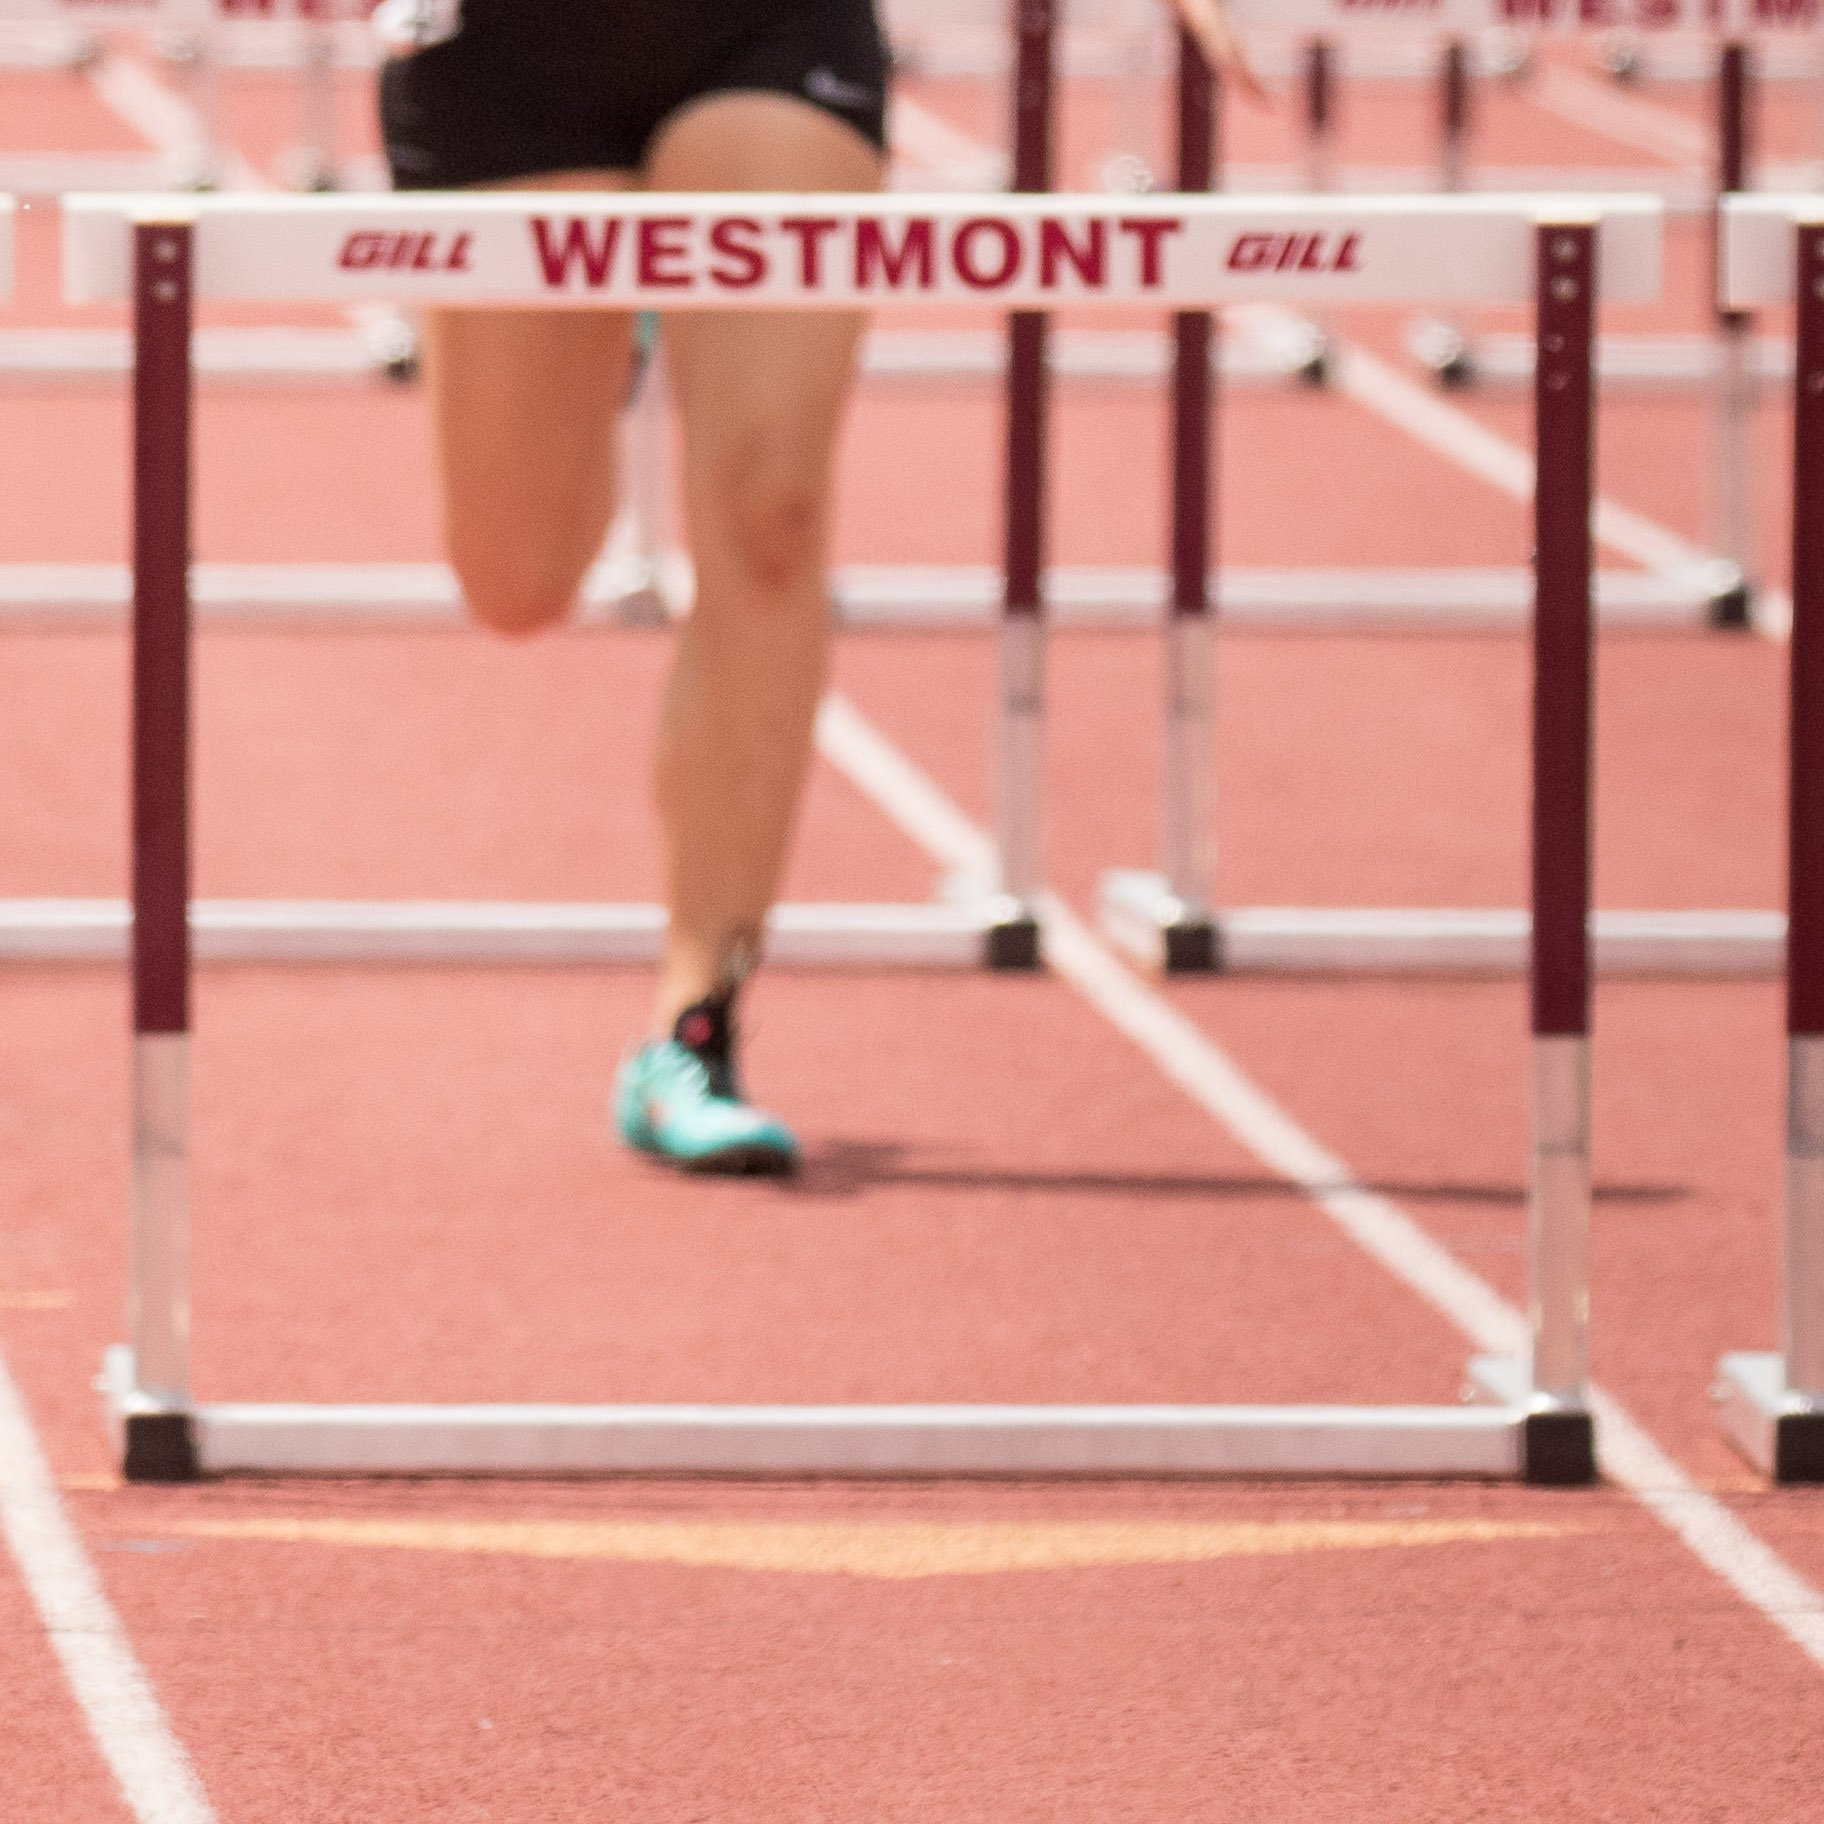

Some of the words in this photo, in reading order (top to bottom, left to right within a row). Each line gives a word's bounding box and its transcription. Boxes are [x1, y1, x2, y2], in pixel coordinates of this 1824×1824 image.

[335, 229, 474, 274] GILL
[530, 217, 1182, 293] WESTMONT
[1223, 230, 1362, 274] GILL
